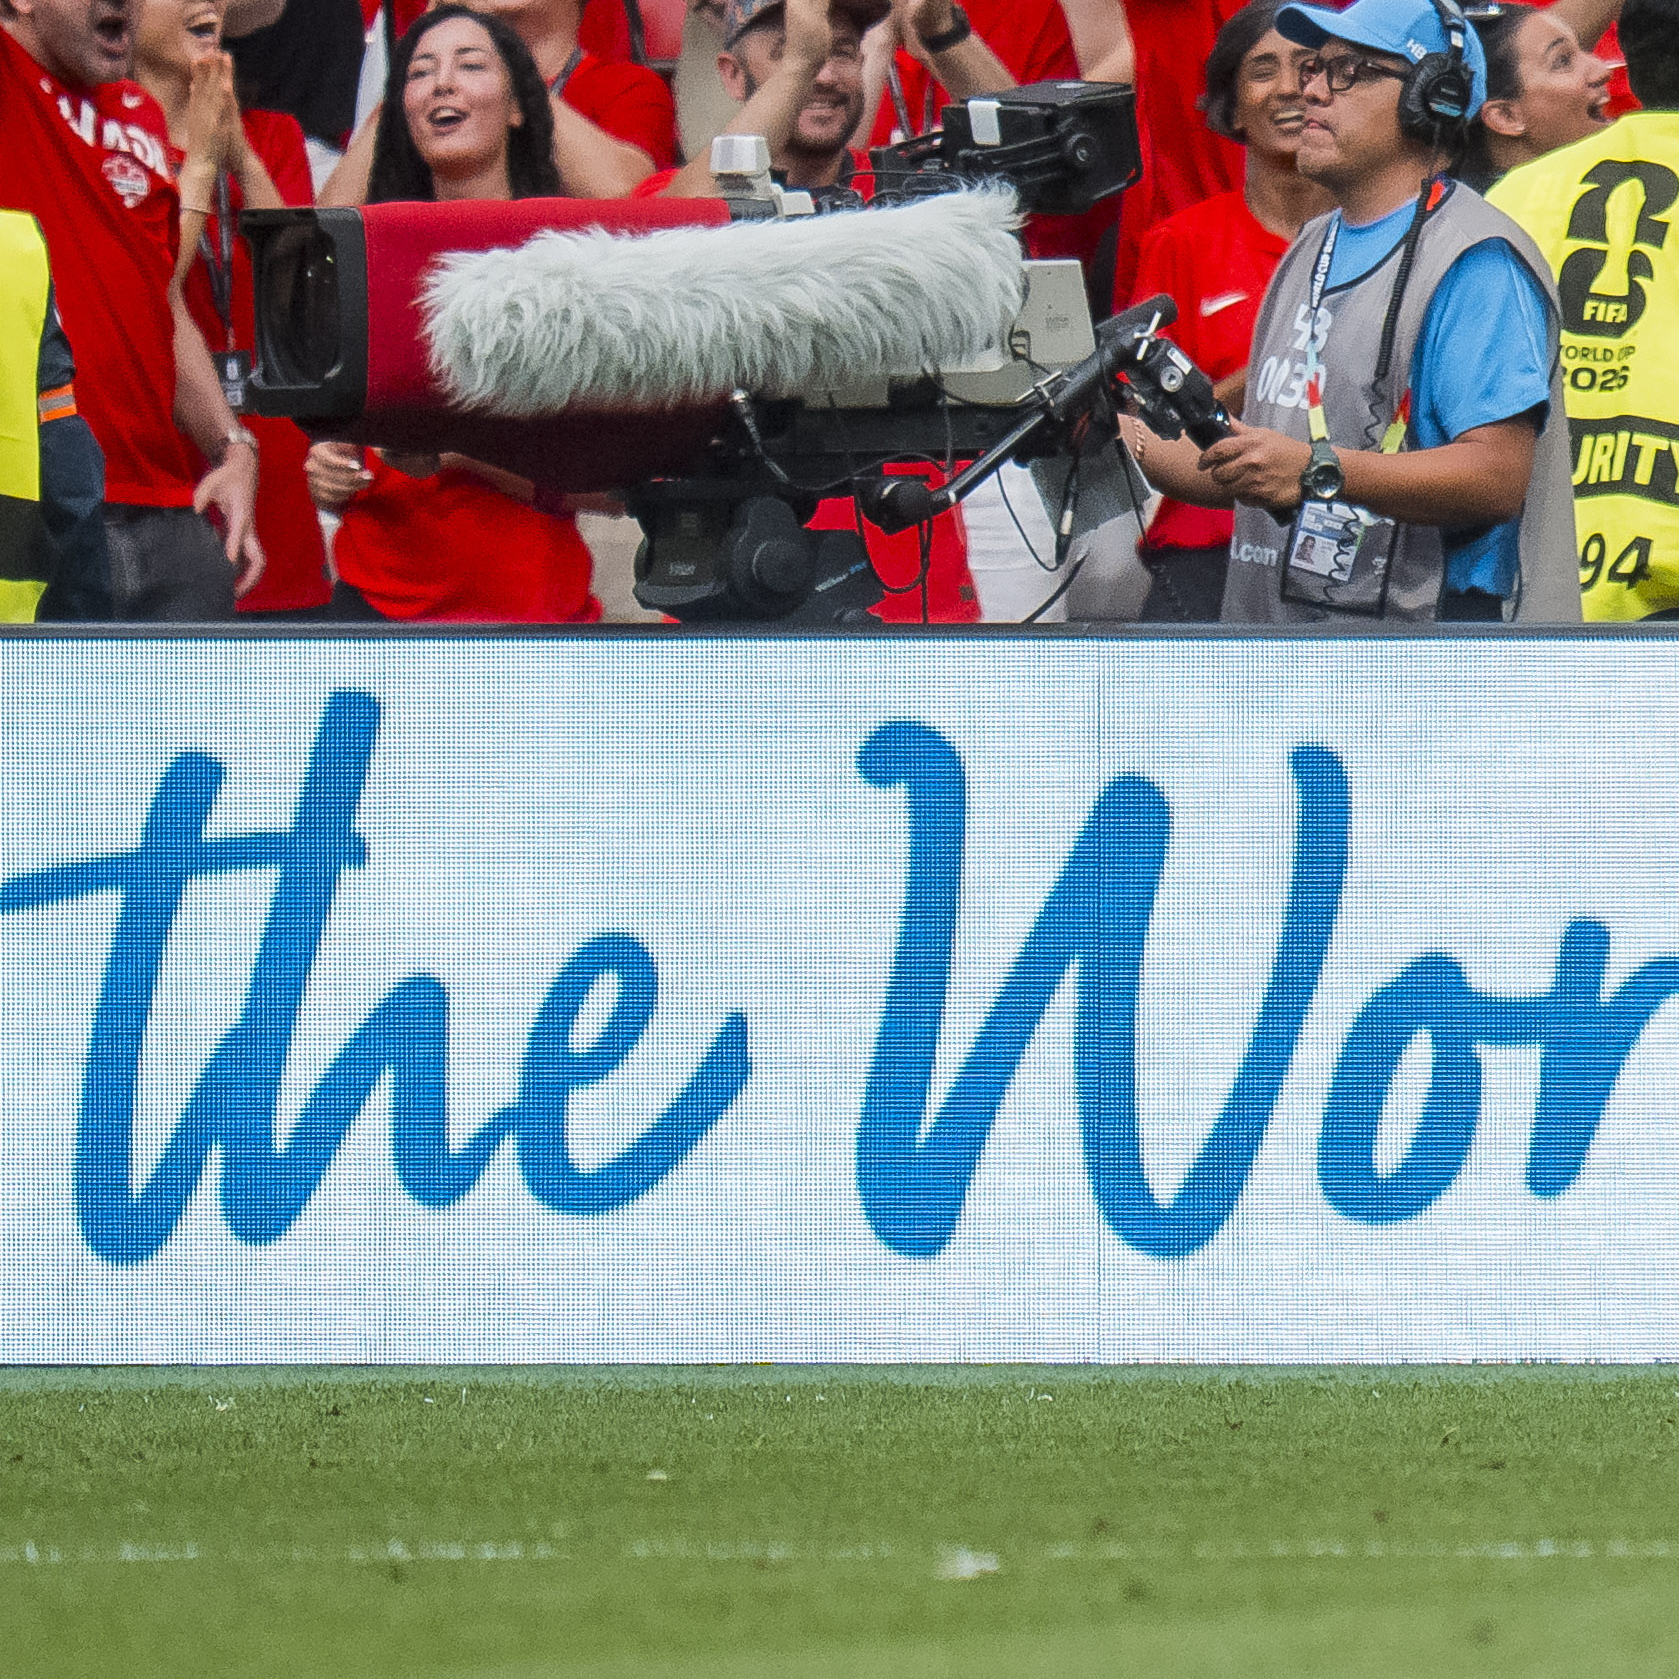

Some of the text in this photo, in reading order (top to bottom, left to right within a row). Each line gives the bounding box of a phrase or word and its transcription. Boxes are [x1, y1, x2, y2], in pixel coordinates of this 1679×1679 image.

[1406, 38, 1428, 60] HB
[1582, 300, 1629, 324] FIFA
[1563, 364, 1631, 394] 026
[0, 689, 752, 1267] the
